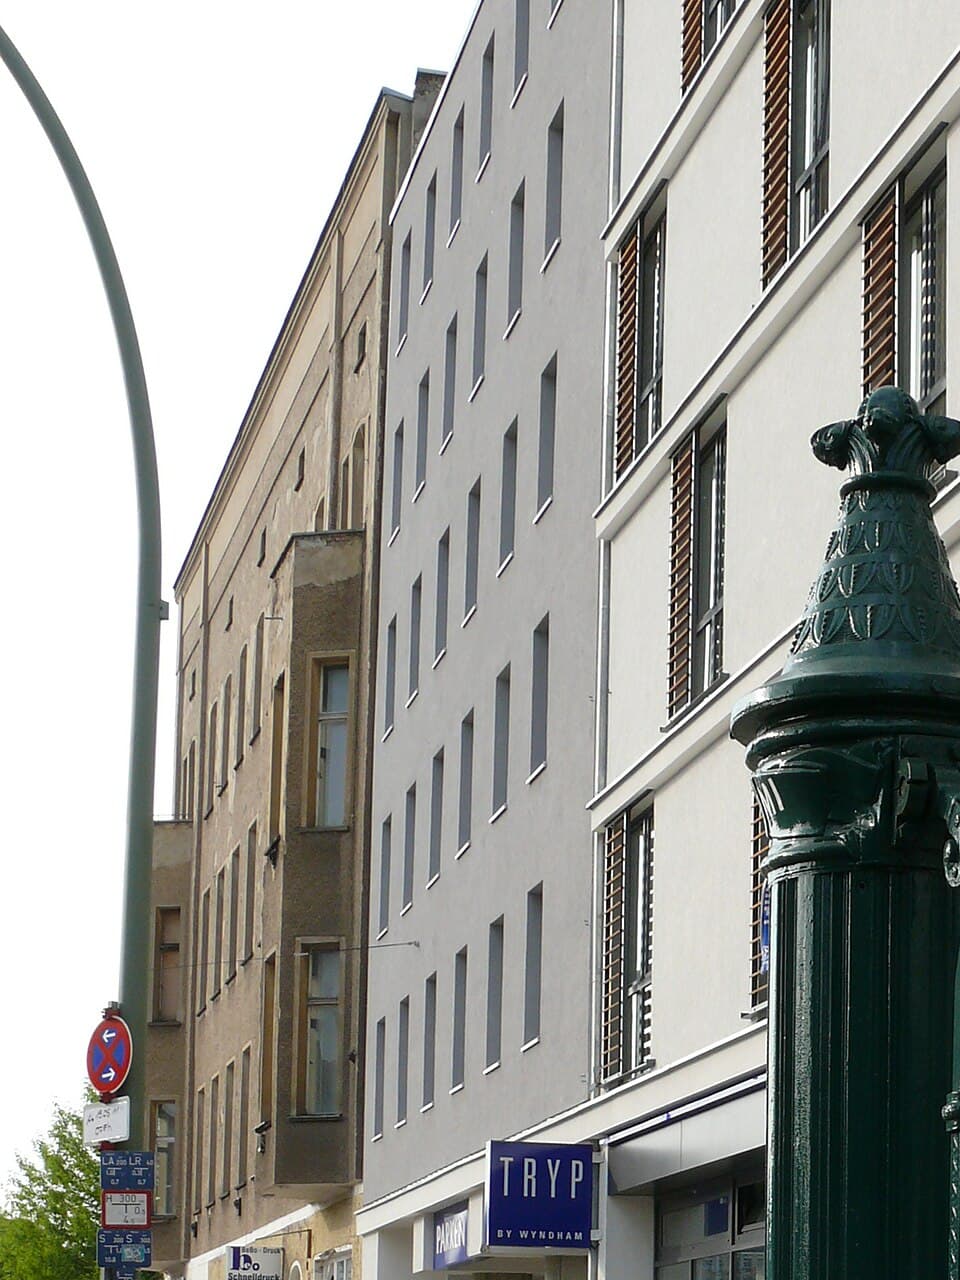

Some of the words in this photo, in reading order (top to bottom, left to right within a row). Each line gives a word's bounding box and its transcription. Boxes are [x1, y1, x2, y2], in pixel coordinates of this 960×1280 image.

[102, 1156, 115, 1166] LA
[129, 1156, 142, 1166] LR
[499, 1156, 585, 1199] TRYP
[106, 1194, 112, 1203] H
[120, 1194, 137, 1203] 300
[436, 1220, 466, 1255] PARKEN
[497, 1229, 513, 1239] BY
[519, 1230, 583, 1241] WYNDHAM
[228, 1273, 280, 1280] Schnelldruck
